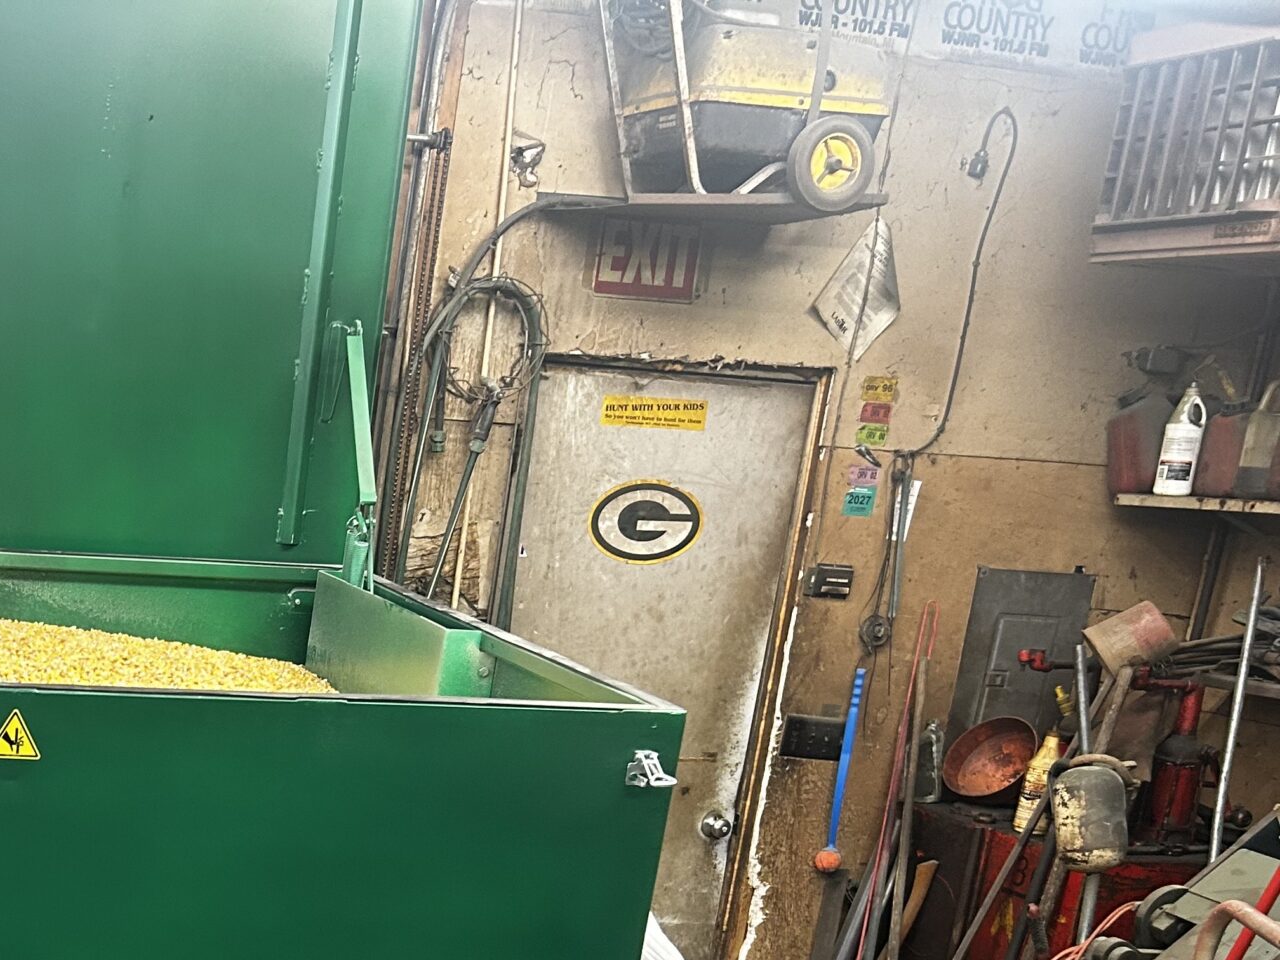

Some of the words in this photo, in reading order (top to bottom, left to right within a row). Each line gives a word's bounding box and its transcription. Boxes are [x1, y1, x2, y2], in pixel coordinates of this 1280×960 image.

[851, 17, 886, 35] 101.5
[888, 22, 910, 38] FM
[943, 1, 1054, 41] COUNTRY
[941, 29, 980, 49] WJNR
[598, 220, 700, 288] EXIT
[605, 403, 629, 412] HUNT
[631, 403, 654, 412] WITH
[656, 403, 681, 411] YOUR
[682, 402, 705, 411] KIDS
[847, 494, 872, 505] 2027
